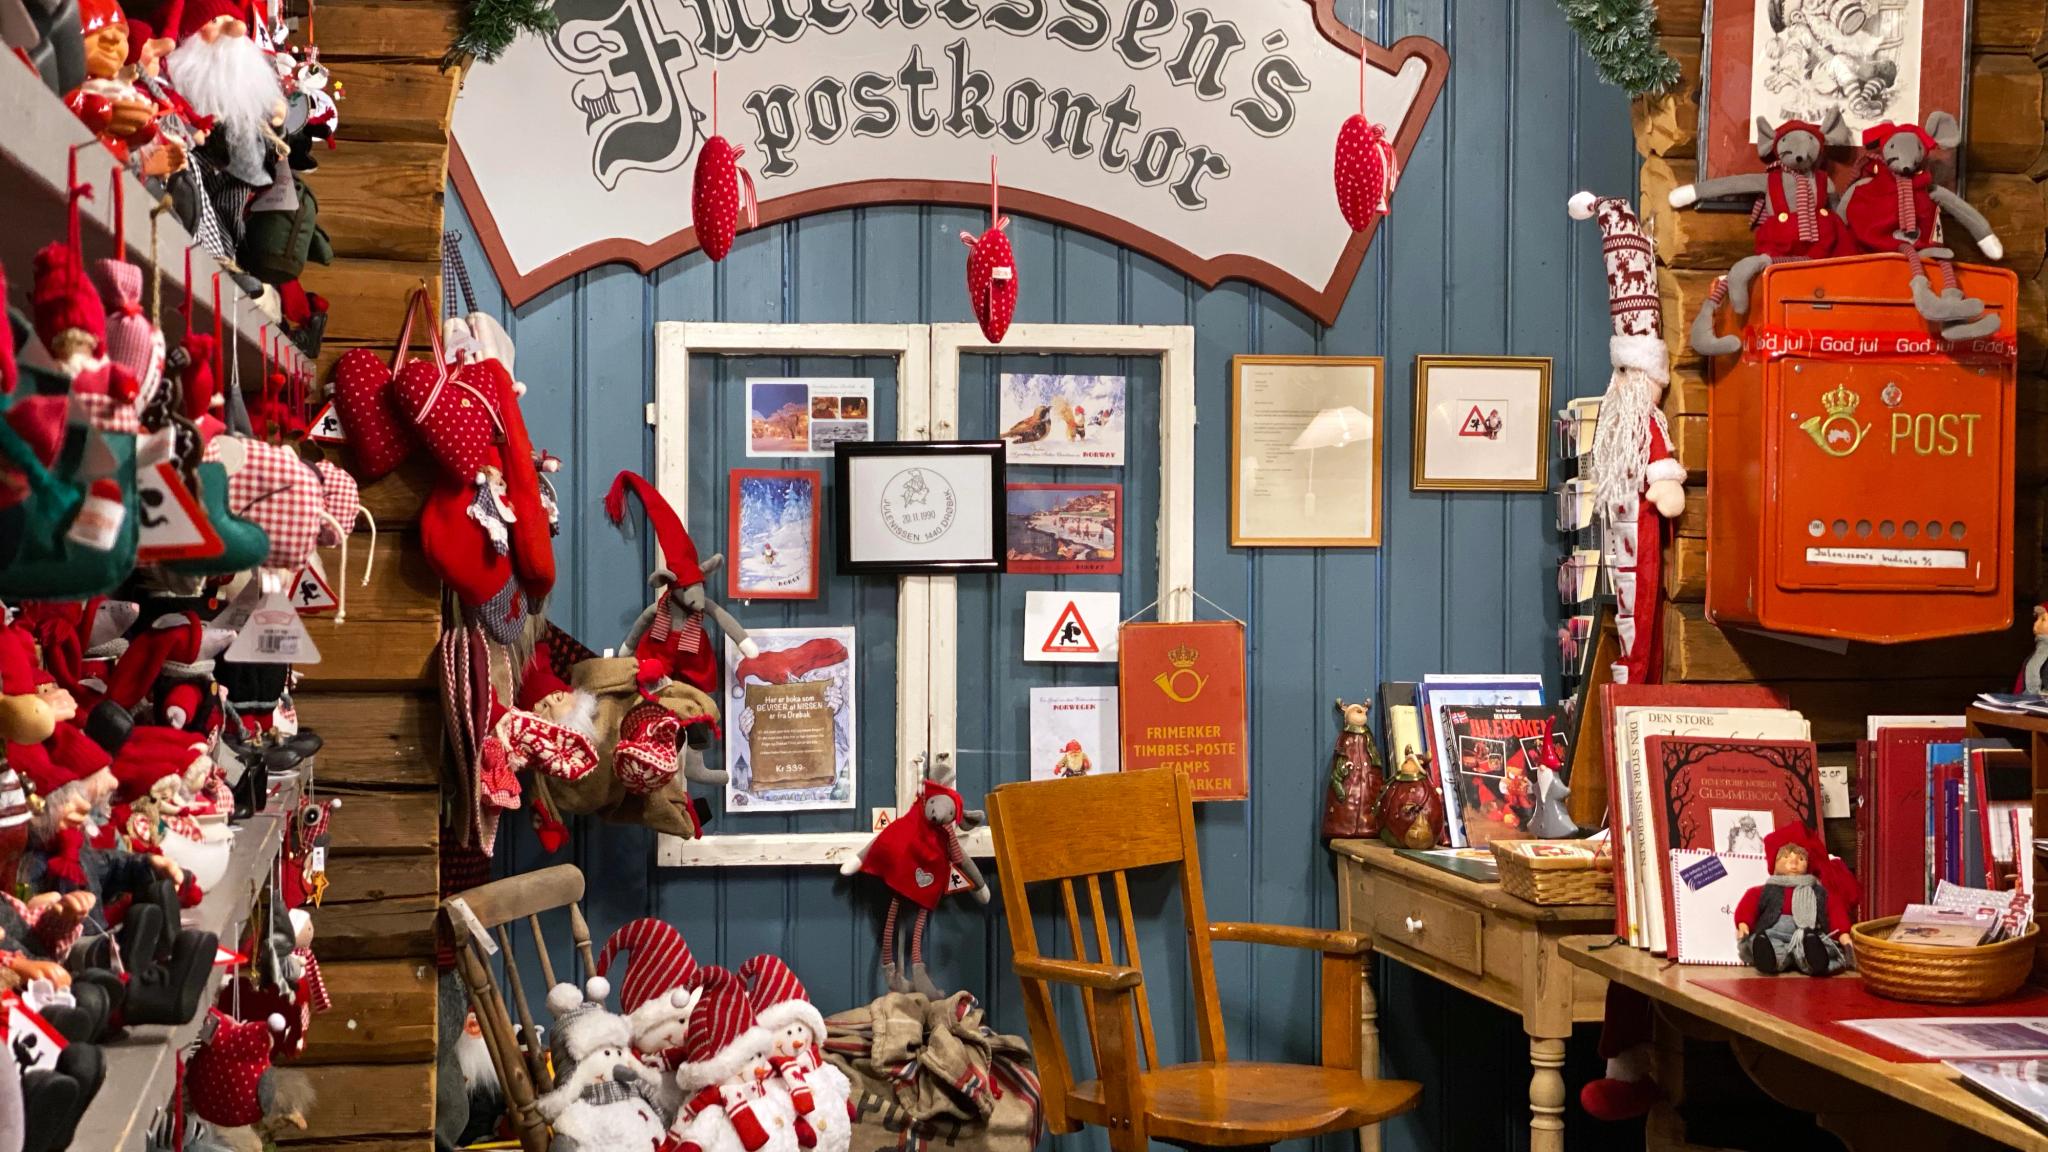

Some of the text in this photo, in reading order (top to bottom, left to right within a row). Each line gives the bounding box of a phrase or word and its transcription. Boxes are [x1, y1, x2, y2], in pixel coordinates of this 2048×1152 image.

[743, 38, 1230, 210] postkontor
[1779, 335, 1803, 354] jul
[1820, 336, 1854, 352] God
[1858, 338, 1879, 354] jul
[1896, 338, 1931, 353] God
[1929, 339, 1954, 355] jul
[1972, 340, 2004, 354] God
[1891, 412, 1982, 457] POST
[884, 498, 920, 541] JULENISSEN
[925, 526, 943, 540] 1440
[756, 703, 788, 711] BEVISER
[1648, 713, 1714, 726] DEN STORE
[1147, 725, 1221, 740] FRIMERKER
[1629, 721, 1640, 745] DEN
[1134, 742, 1236, 757] TIMBRES-POSTE
[775, 765, 785, 773] Kr
[1631, 748, 1641, 786] STORE
[1699, 786, 1782, 801] GLEMMEBOKA
[1634, 790, 1647, 867] NISSEBOKEN
